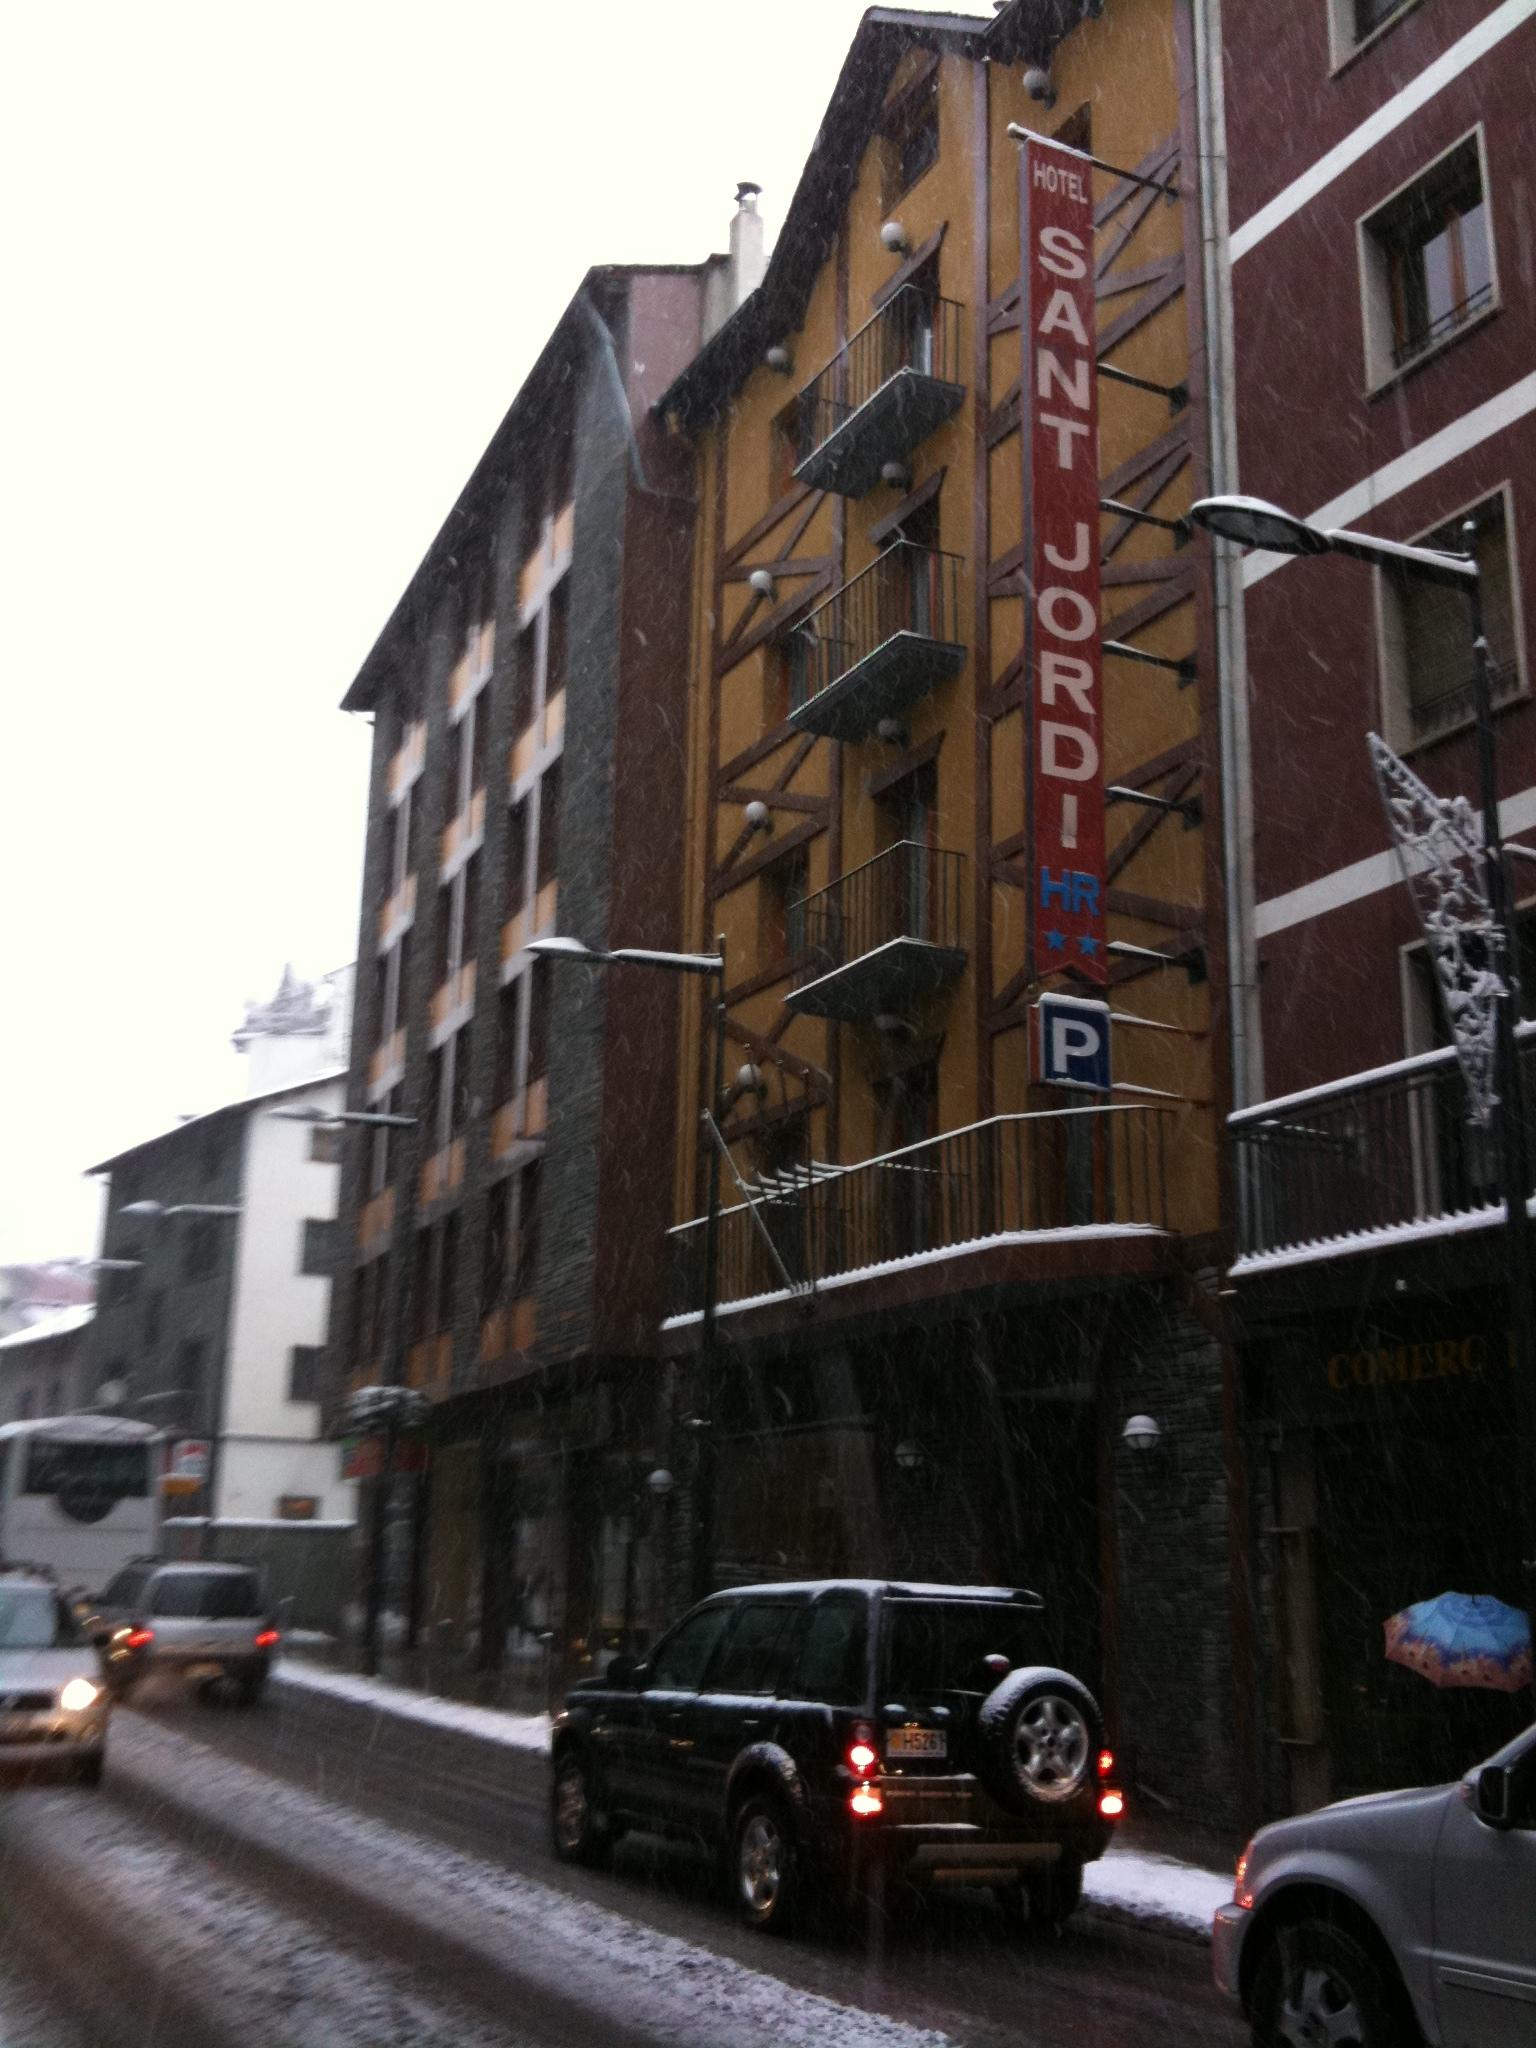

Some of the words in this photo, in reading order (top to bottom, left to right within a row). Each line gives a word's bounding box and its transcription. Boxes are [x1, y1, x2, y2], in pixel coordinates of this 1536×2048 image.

[1033, 160, 1089, 205] HOTEL
[1037, 226, 1091, 470] SANT
[1037, 522, 1099, 849] JORDI
[1041, 865, 1100, 918] HR
[1052, 1017, 1100, 1073] P
